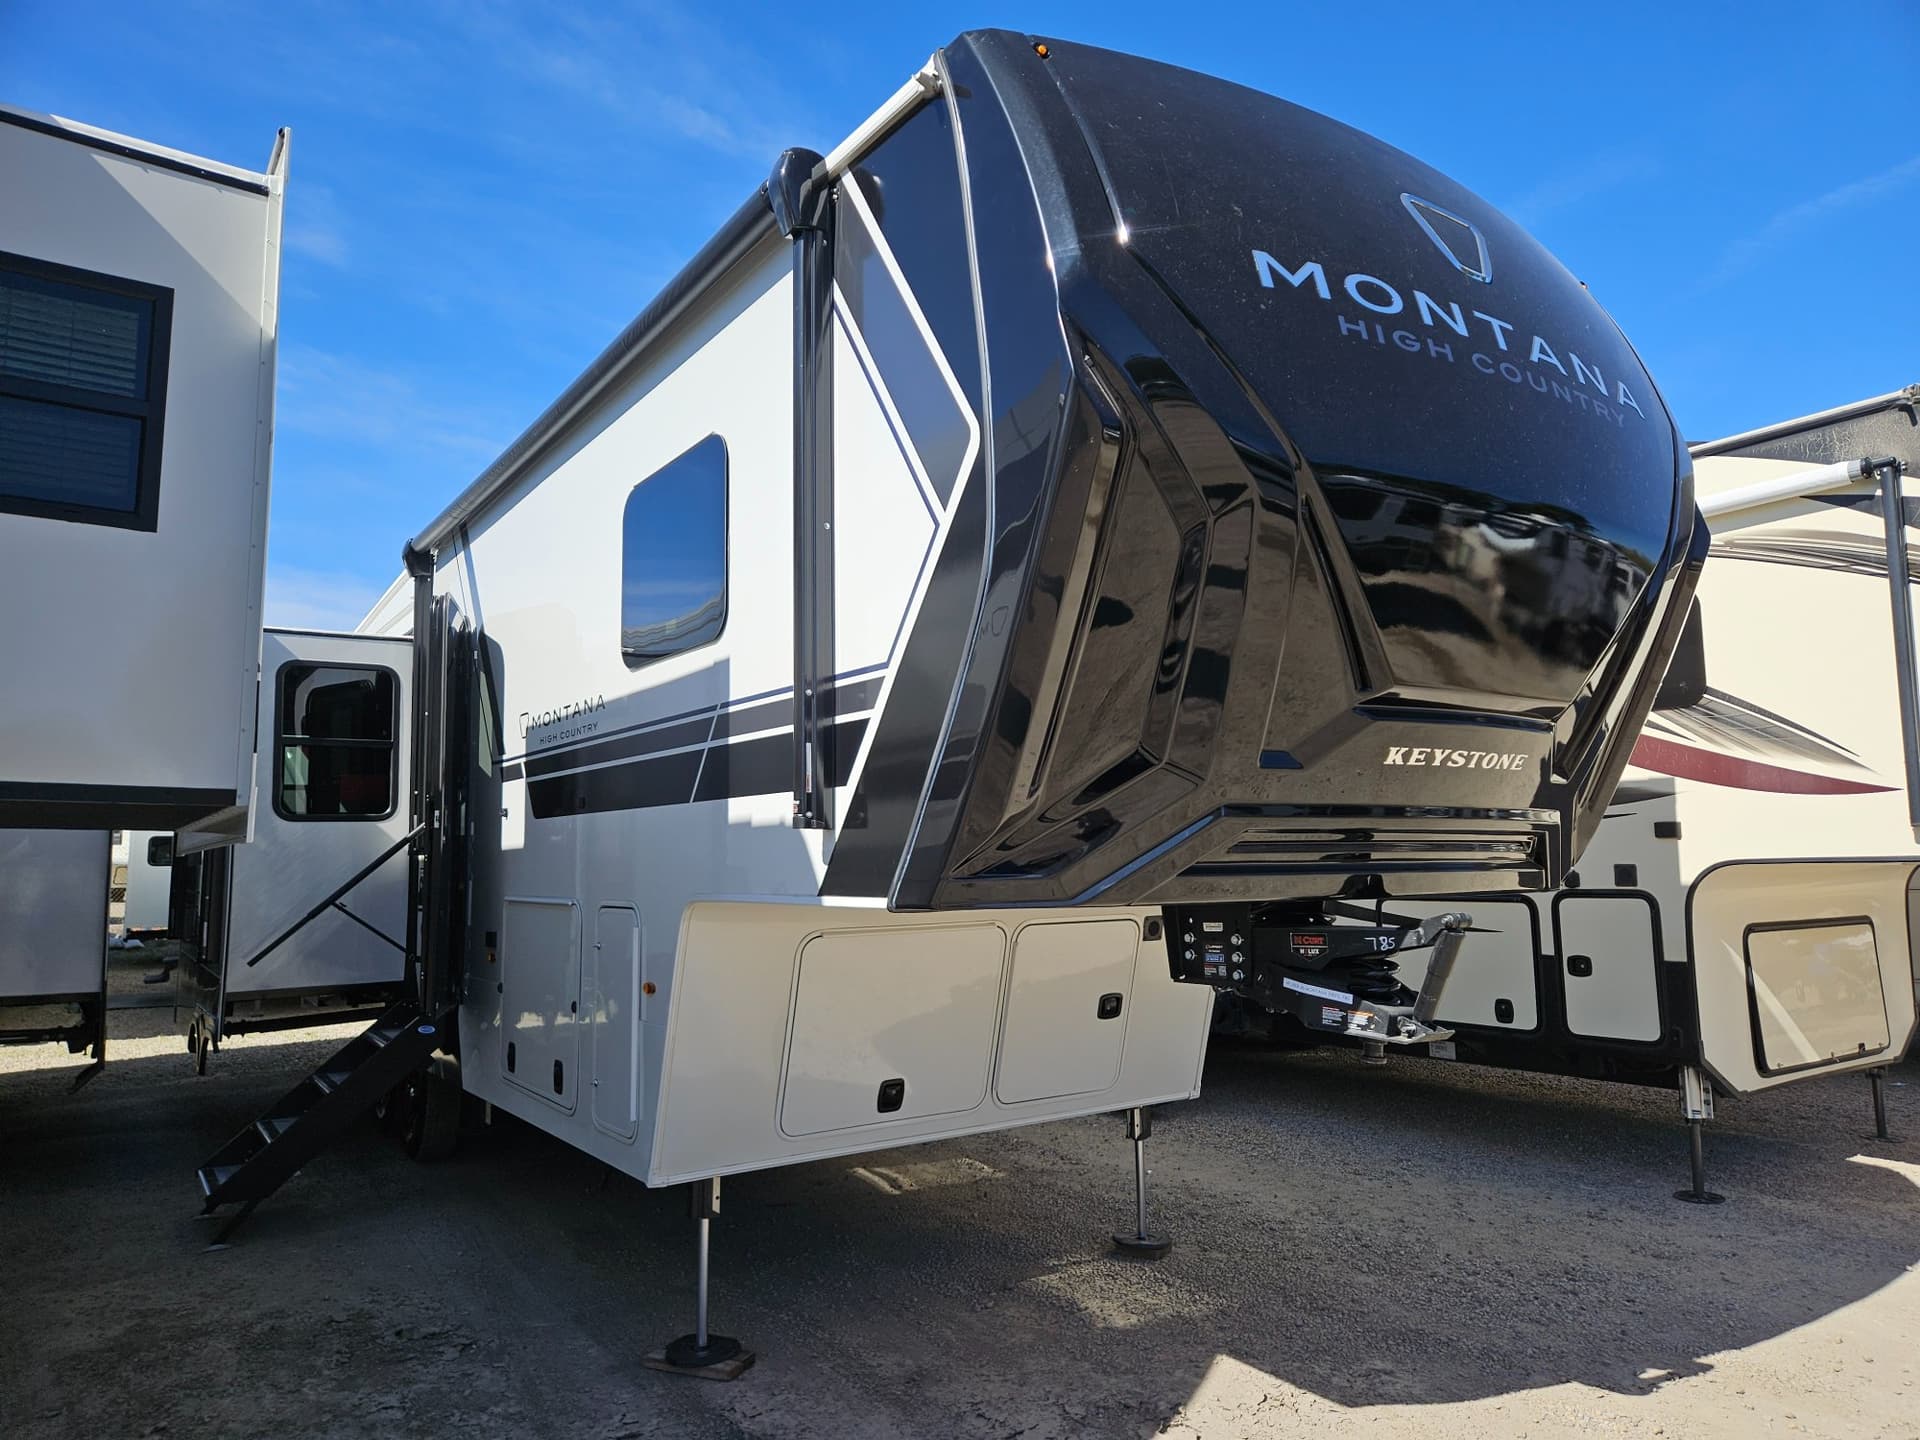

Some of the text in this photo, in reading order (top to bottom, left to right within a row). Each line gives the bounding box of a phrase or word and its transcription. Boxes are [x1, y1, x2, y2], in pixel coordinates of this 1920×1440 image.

[1251, 249, 1646, 420] MONTANA
[1338, 315, 1626, 429] HIGH COUNTRY
[531, 694, 606, 730] MONTANA
[540, 721, 599, 744] HIGH COUNTRY
[1383, 746, 1529, 771] KEYSTONE
